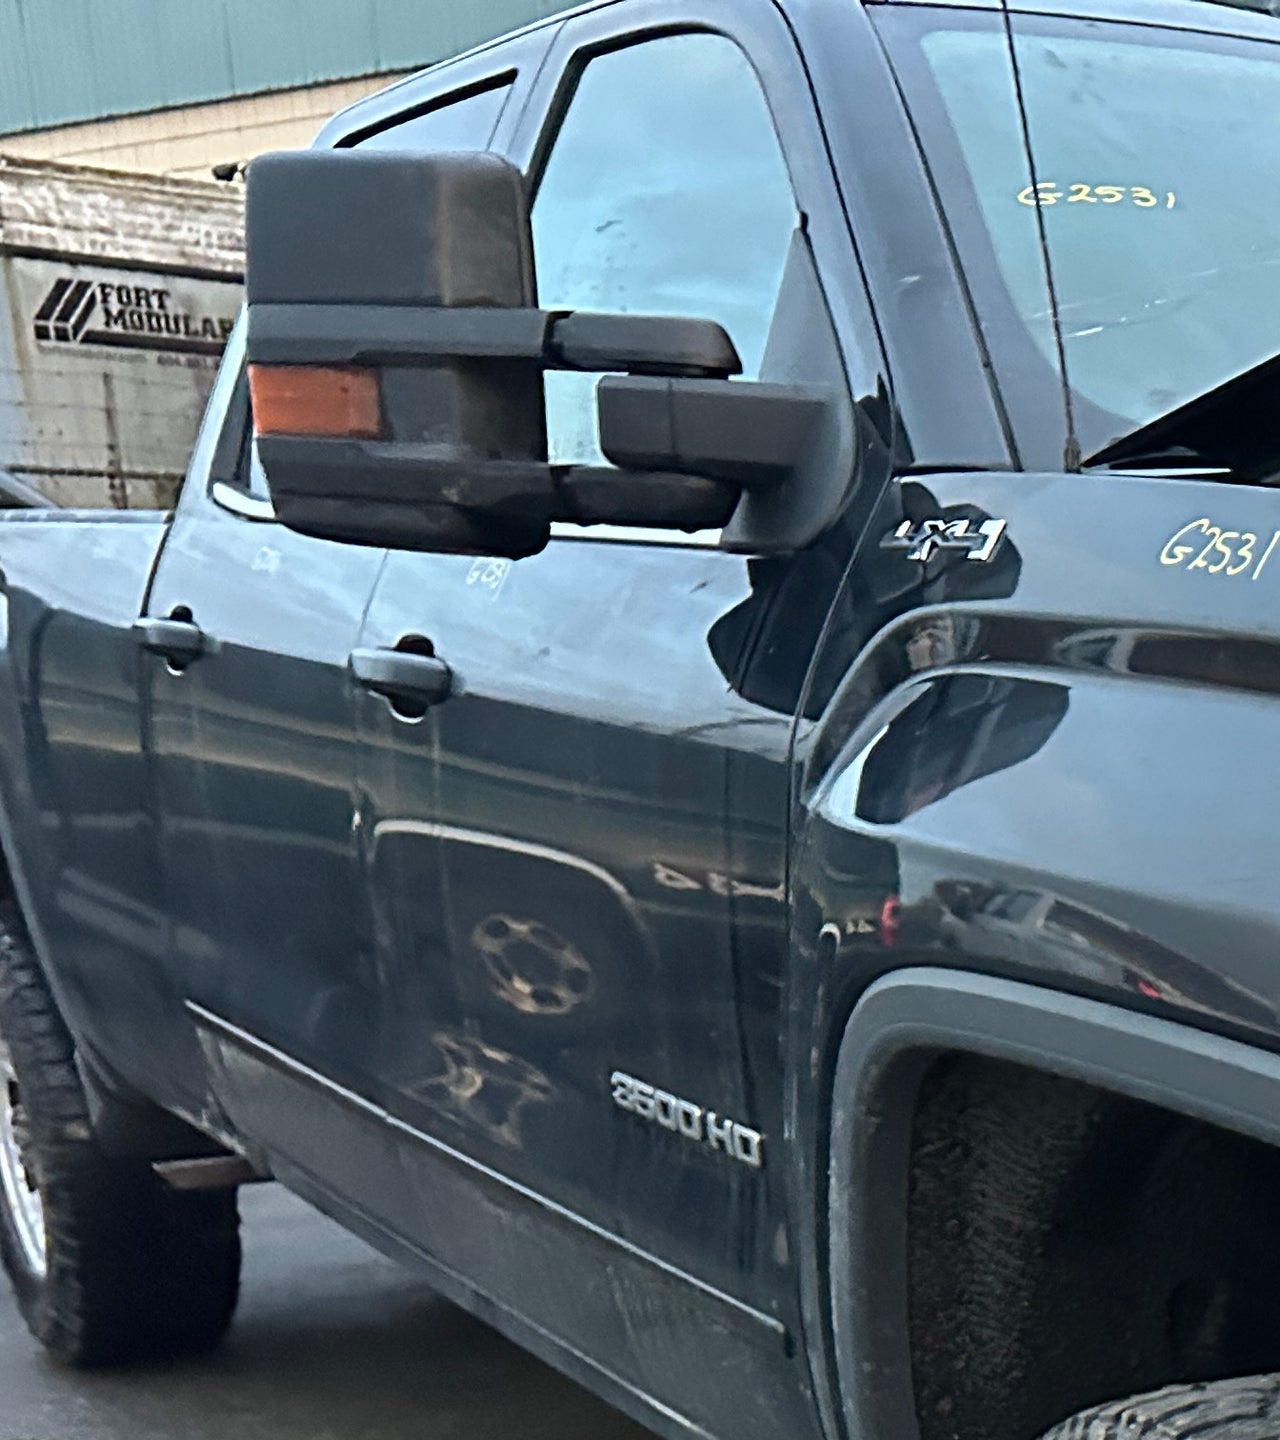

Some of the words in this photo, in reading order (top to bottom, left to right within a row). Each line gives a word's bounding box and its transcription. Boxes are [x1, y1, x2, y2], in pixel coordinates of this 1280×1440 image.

[1016, 182, 1177, 210] G2531
[97, 282, 171, 311] FORT
[1158, 516, 1280, 581] G2531
